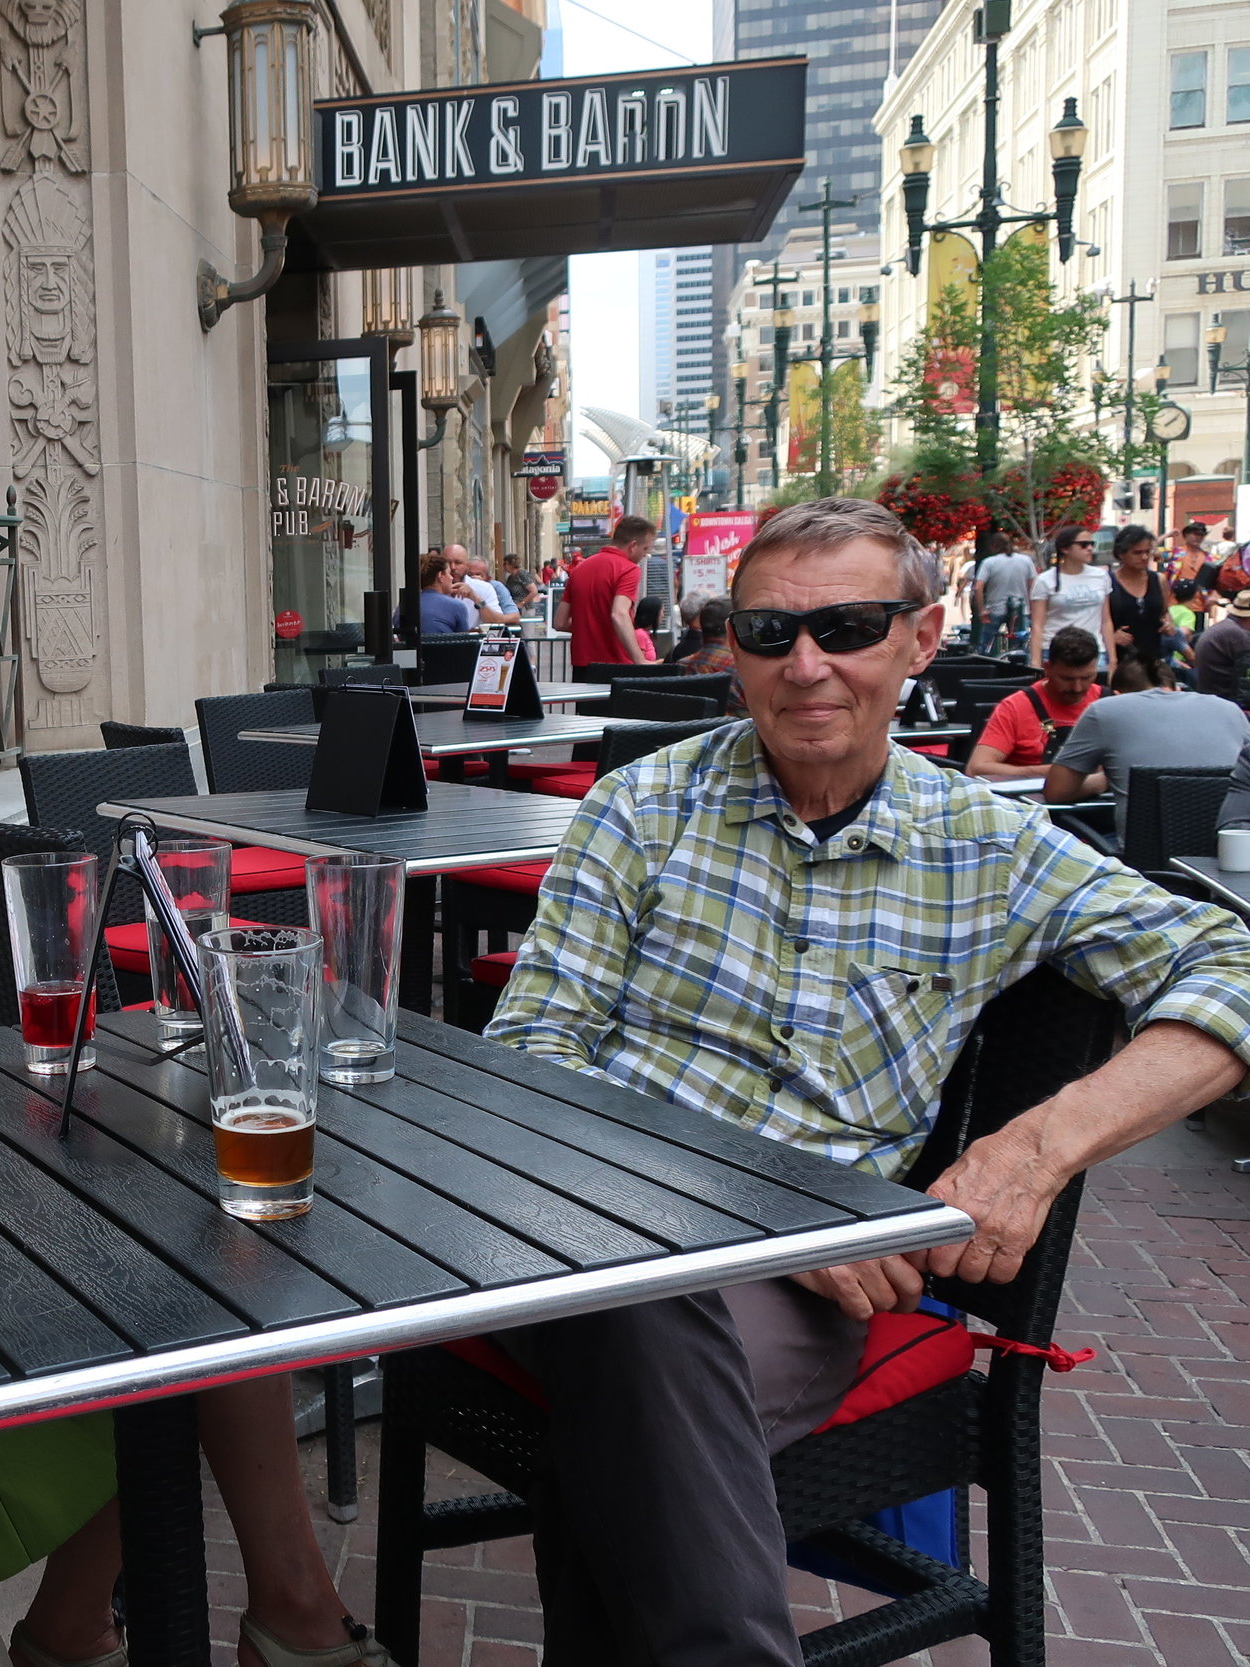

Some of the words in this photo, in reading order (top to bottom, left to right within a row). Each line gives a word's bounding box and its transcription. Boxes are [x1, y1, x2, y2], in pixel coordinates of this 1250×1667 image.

[335, 99, 476, 187] BANK
[489, 95, 525, 174] &
[541, 75, 730, 171] BARON
[513, 464, 561, 476] atagonia
[277, 477, 290, 505] &
[296, 476, 367, 517] BARON
